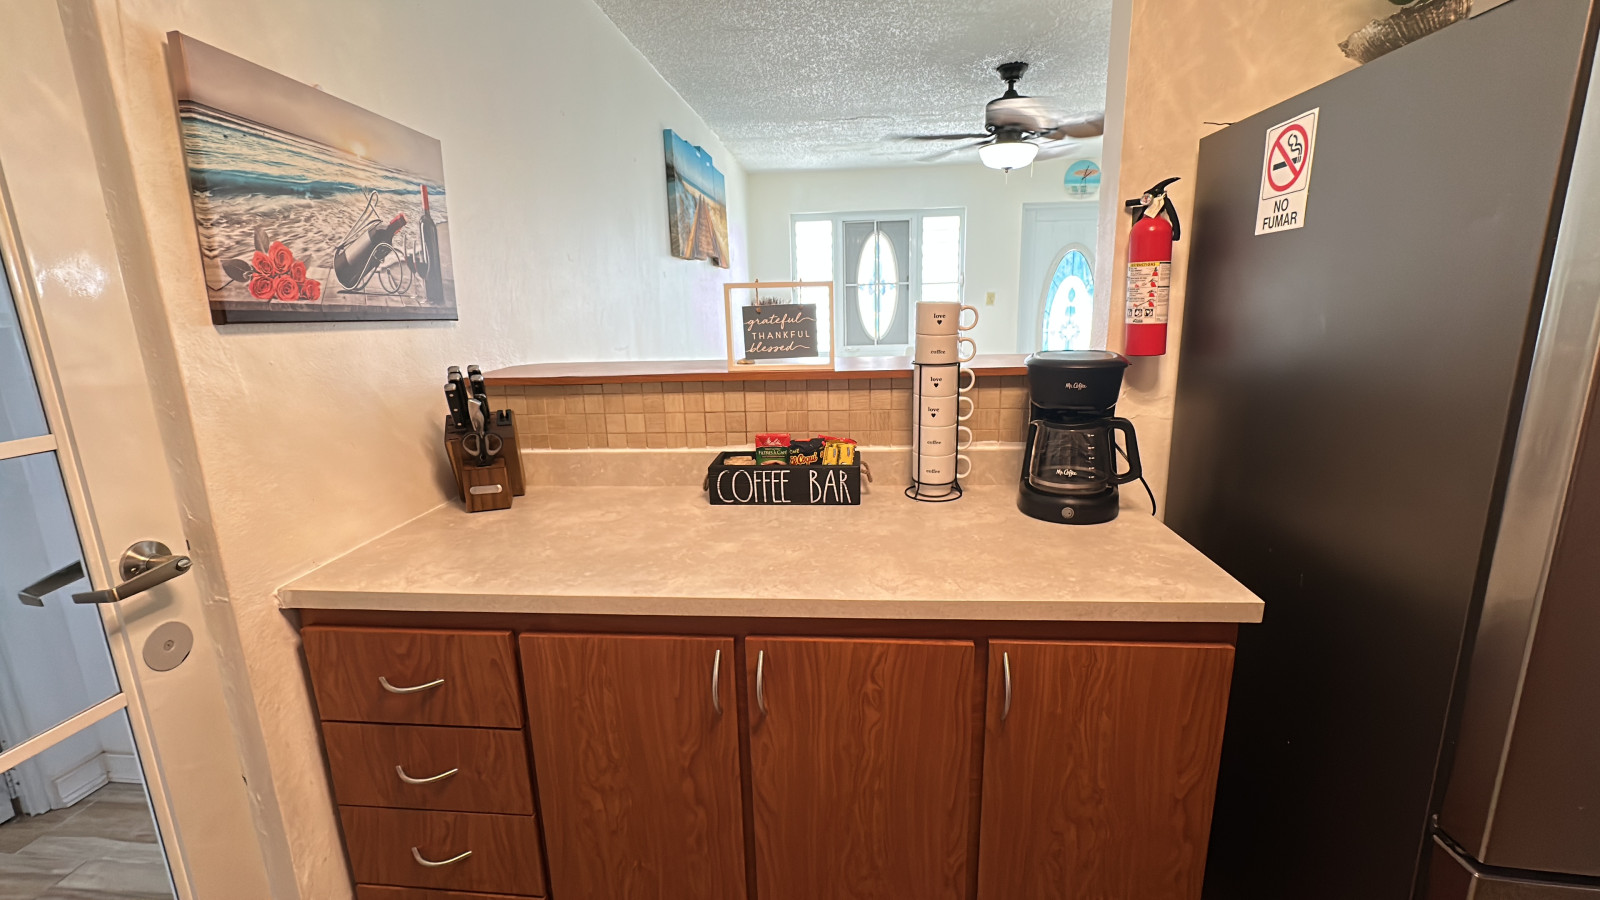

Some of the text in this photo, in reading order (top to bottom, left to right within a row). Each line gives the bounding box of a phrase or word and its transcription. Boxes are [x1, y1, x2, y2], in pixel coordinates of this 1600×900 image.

[1273, 198, 1289, 214] NO
[1262, 211, 1298, 230] FUMAR
[744, 312, 816, 331] grateful
[751, 330, 811, 340] THANKFUL
[746, 341, 810, 353] blessed
[717, 469, 852, 504] COFFEE BAR
